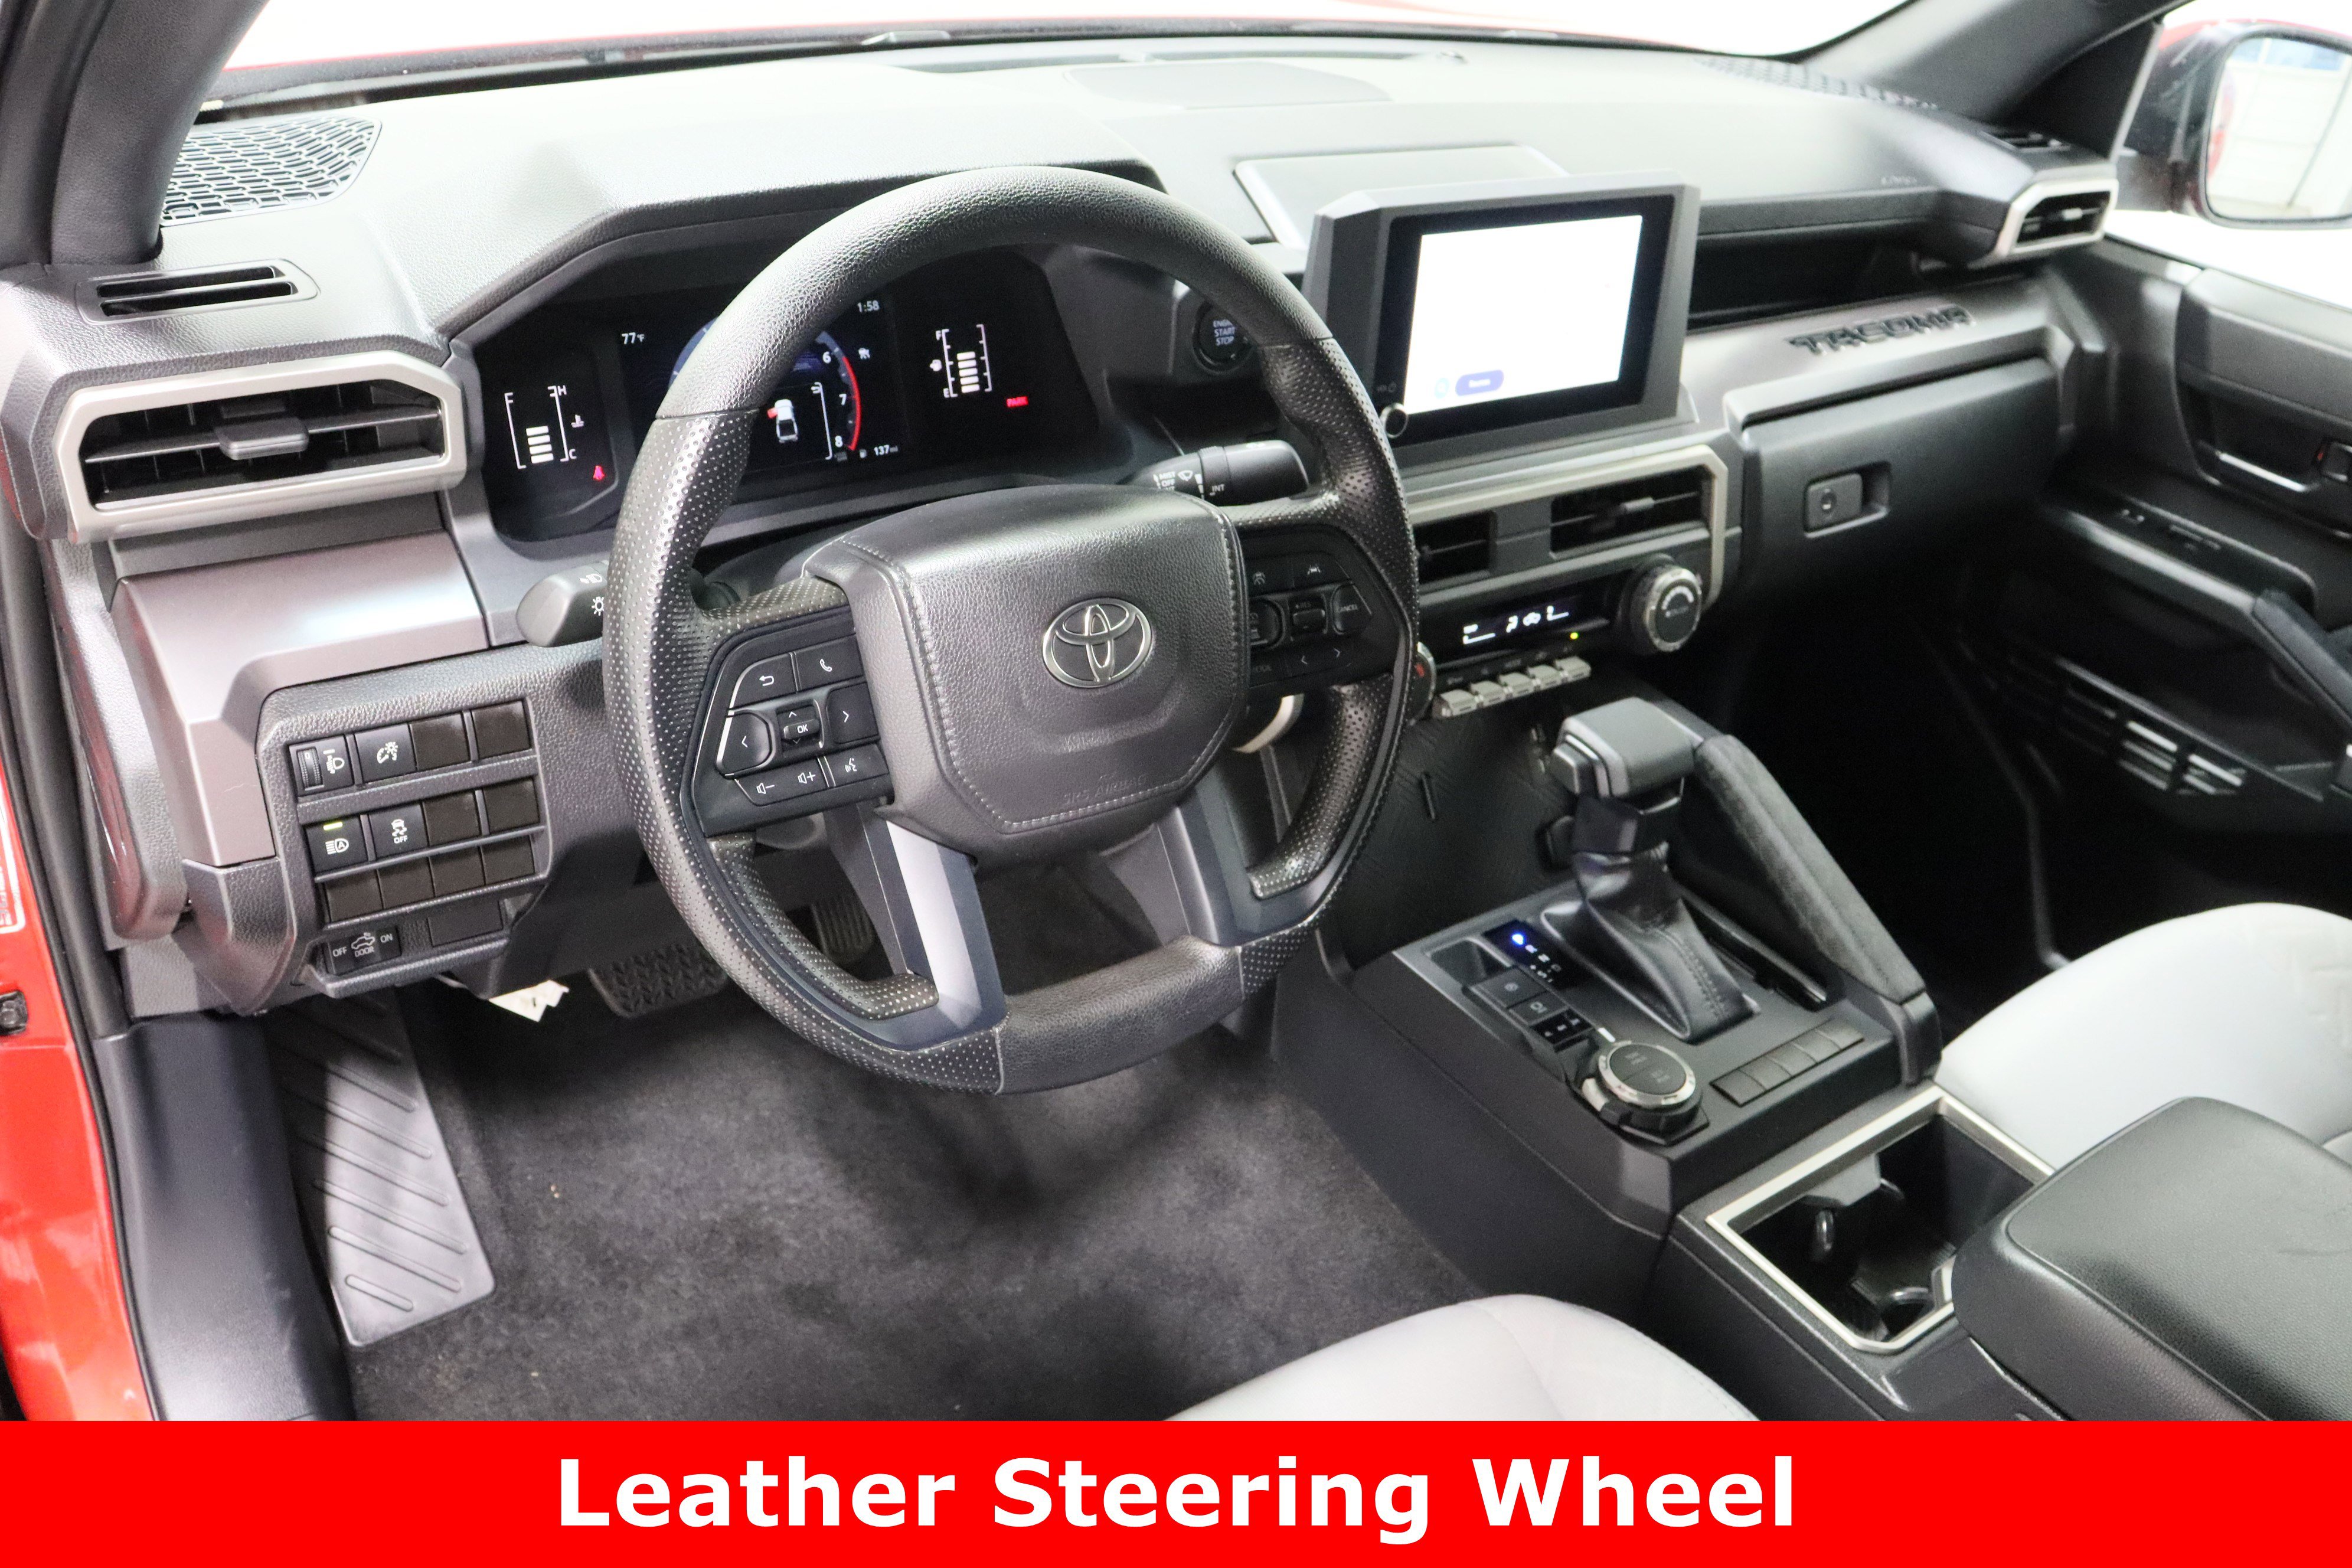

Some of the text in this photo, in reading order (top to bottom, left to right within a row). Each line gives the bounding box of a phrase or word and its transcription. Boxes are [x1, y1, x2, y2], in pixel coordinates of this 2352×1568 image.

[857, 300, 880, 313] 1:58
[1214, 326, 1236, 337] START
[1788, 304, 1977, 356] TACOMA
[1216, 336, 1234, 347] STOP
[822, 351, 832, 364] 6
[838, 393, 847, 406] 7
[834, 435, 844, 448] 8
[568, 448, 577, 460] C
[1211, 484, 1225, 493] INT
[796, 723, 809, 734] OK
[393, 835, 409, 844] OFF
[380, 933, 393, 943] ON
[332, 946, 375, 958] OFF DOOR
